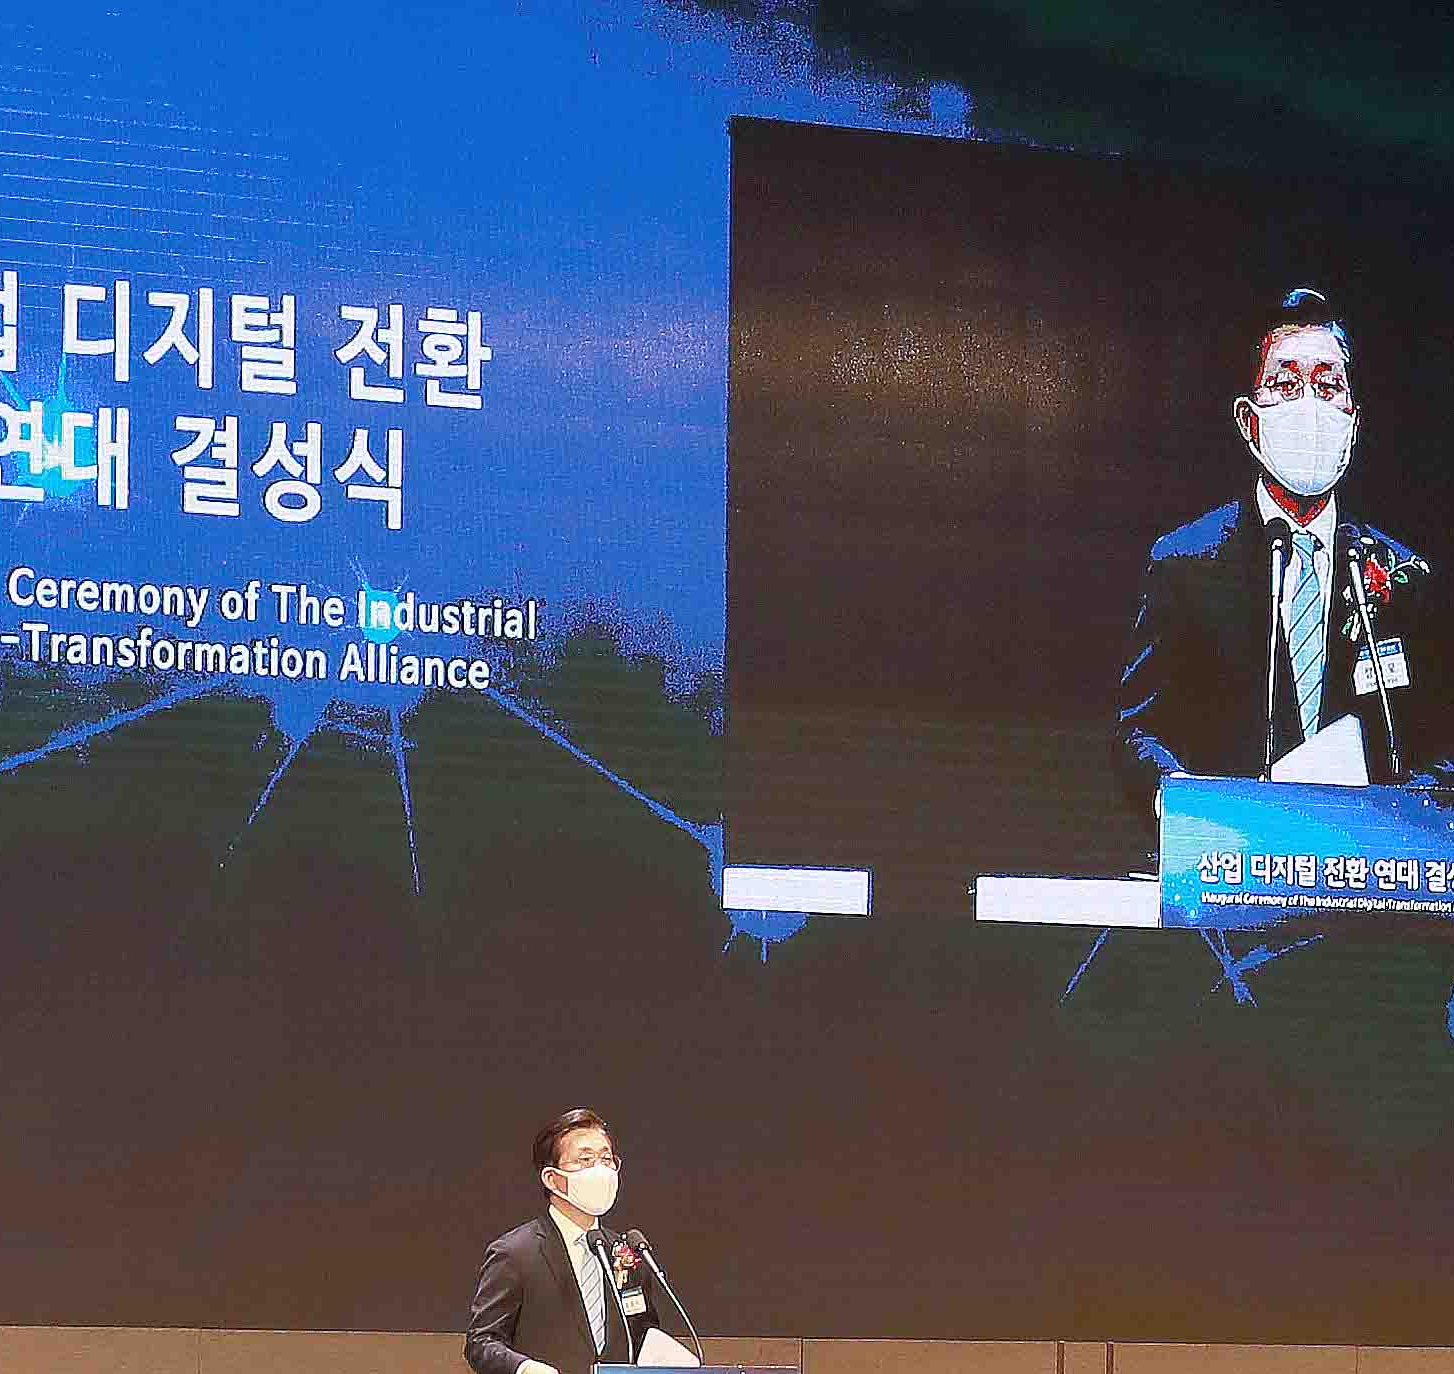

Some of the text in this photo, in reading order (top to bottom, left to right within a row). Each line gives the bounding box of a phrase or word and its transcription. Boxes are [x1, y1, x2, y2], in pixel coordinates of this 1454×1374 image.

[62, 279, 299, 396] 디지털
[332, 301, 492, 410] 전환
[169, 415, 406, 530] 결성식
[7, 565, 208, 630] Ceremony
[220, 578, 259, 623] of
[271, 584, 345, 628] The
[356, 588, 540, 641] Industrial
[339, 650, 491, 691] Alliance
[1196, 851, 1243, 884] 산업
[1249, 854, 1317, 888] 디지털
[1323, 857, 1369, 891] 전환
[1372, 859, 1419, 892] 연대
